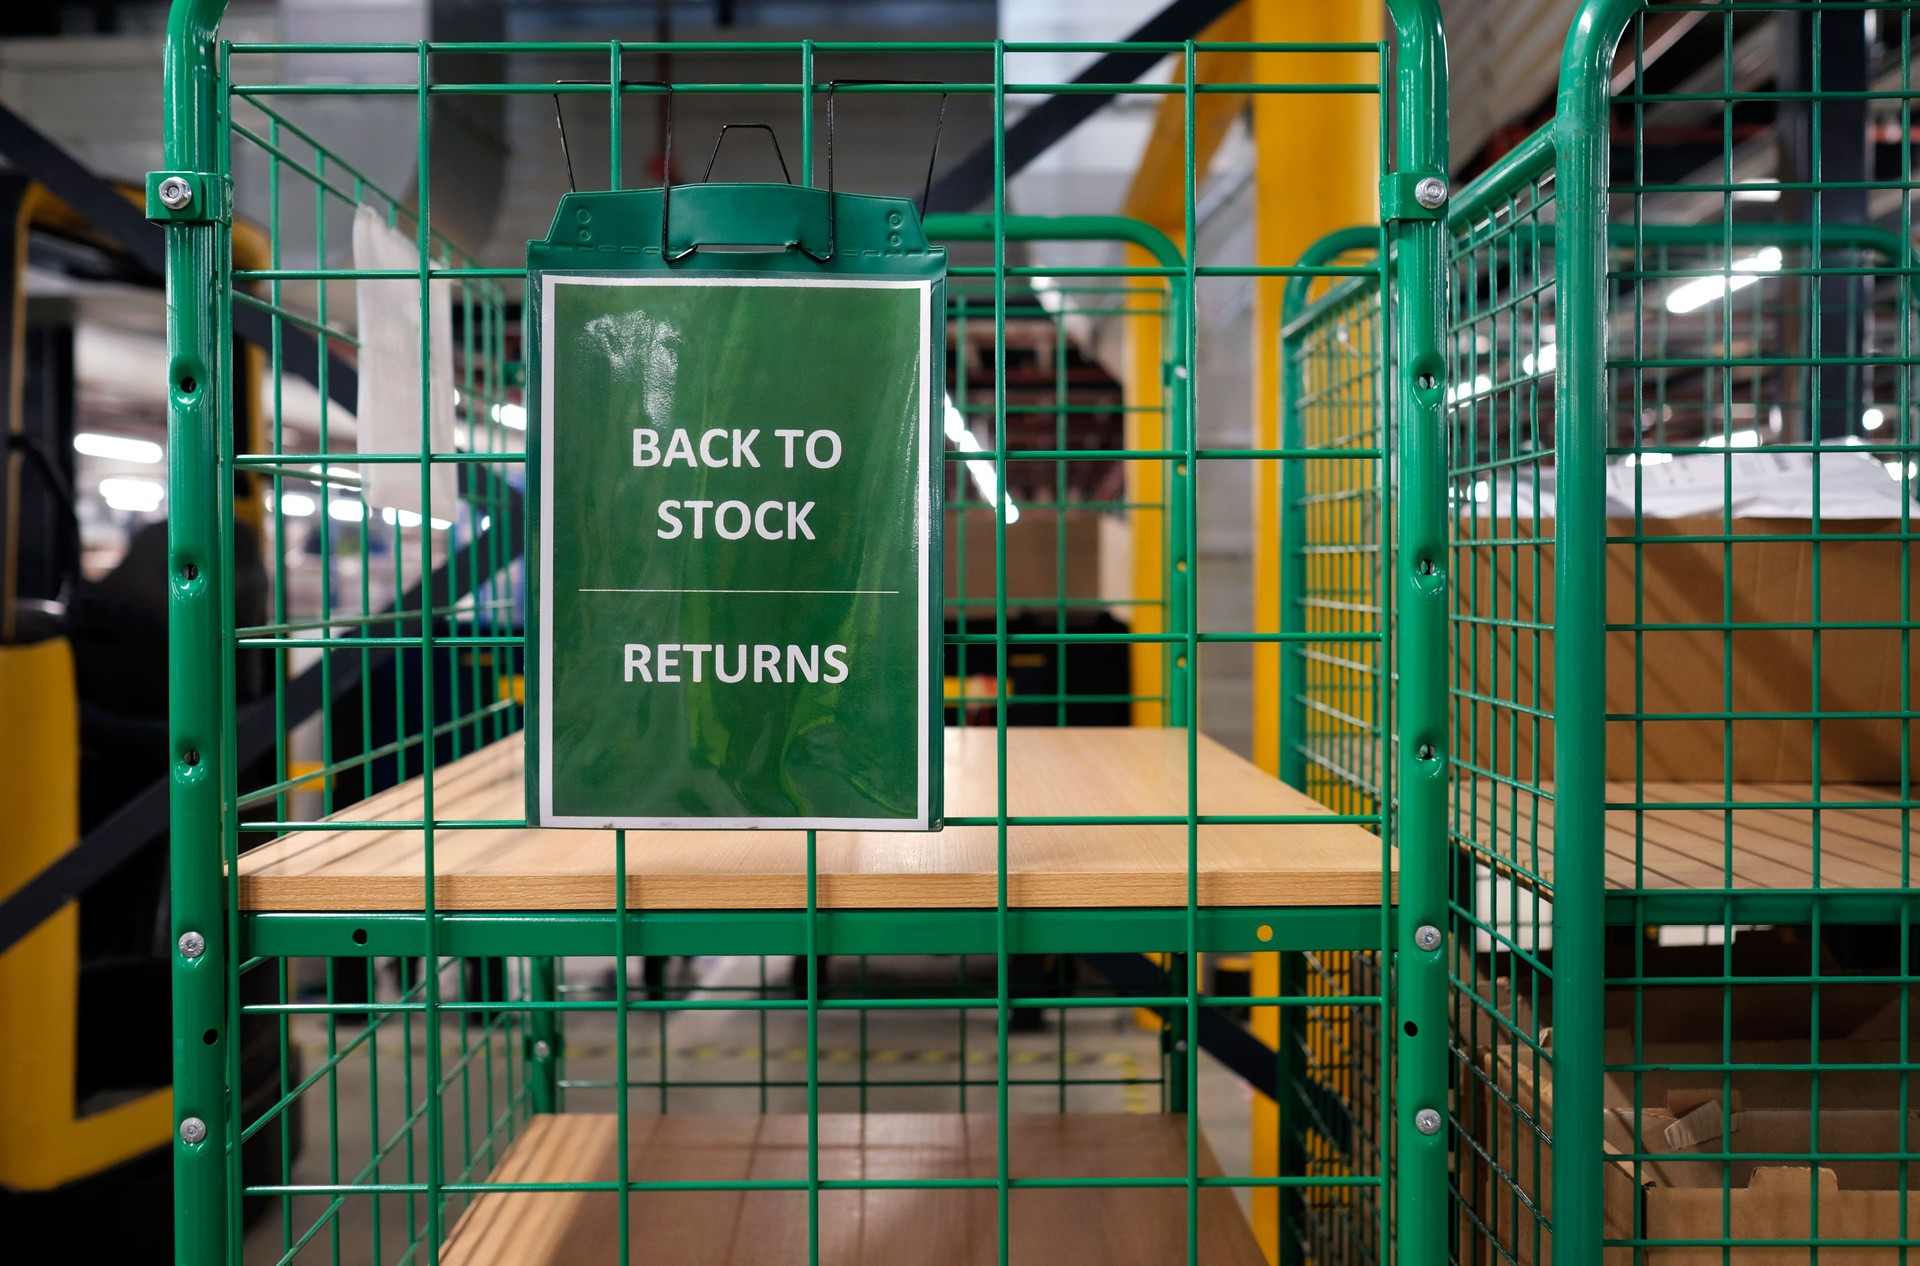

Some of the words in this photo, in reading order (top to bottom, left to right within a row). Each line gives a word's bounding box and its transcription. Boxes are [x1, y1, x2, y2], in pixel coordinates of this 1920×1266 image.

[632, 427, 761, 469] BACK
[774, 429, 842, 469] TO
[656, 499, 816, 541] STOCK
[624, 643, 849, 684] RETURNS
